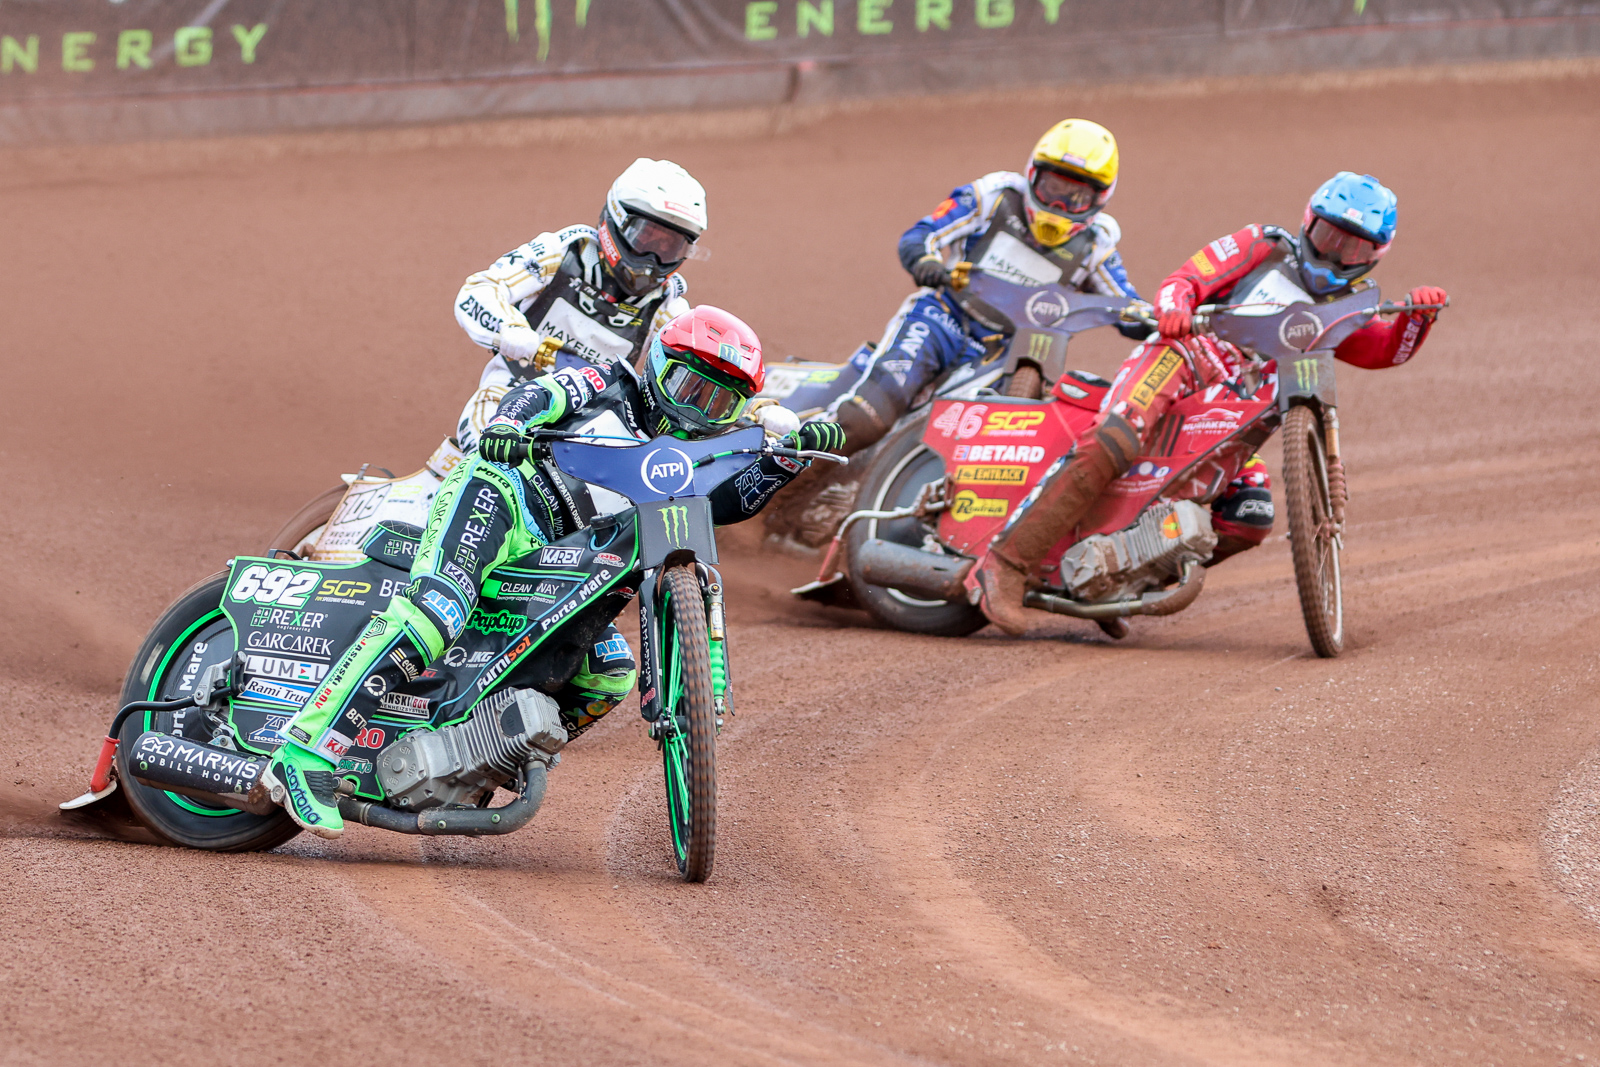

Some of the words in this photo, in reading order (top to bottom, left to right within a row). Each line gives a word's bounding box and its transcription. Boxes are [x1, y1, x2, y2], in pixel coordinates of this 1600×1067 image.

[745, 0, 1066, 41] ENERGY
[2, 23, 268, 74] NERGY
[933, 402, 988, 438] 46
[983, 411, 1046, 431] SGP
[651, 462, 684, 479] ATPI
[968, 445, 1045, 463] BETARD
[532, 474, 560, 512] CLEAN
[551, 471, 563, 486] 692
[559, 483, 577, 512] PATRYK
[460, 488, 499, 550] REXER
[542, 547, 580, 564] KAREX
[229, 564, 322, 607] 692
[317, 579, 372, 597] SGP
[500, 582, 532, 593] CLEAN
[536, 583, 559, 595] WAY
[541, 600, 578, 631] Porta
[579, 569, 612, 601] Mare
[269, 608, 324, 629] REXER
[467, 610, 526, 634] PapCup
[247, 631, 335, 656] GARCAREK
[467, 651, 495, 663] JKG
[179, 641, 209, 692] Mare
[246, 657, 325, 682] LUMEL
[332, 638, 366, 686] JASINSKI
[476, 635, 532, 692] Furnisol
[248, 681, 282, 697] Rami
[172, 707, 187, 738] ort
[136, 751, 193, 774] MOBILE
[202, 770, 252, 790] HOMES
[173, 744, 260, 779] MARWIS
[286, 763, 322, 826] daytona
